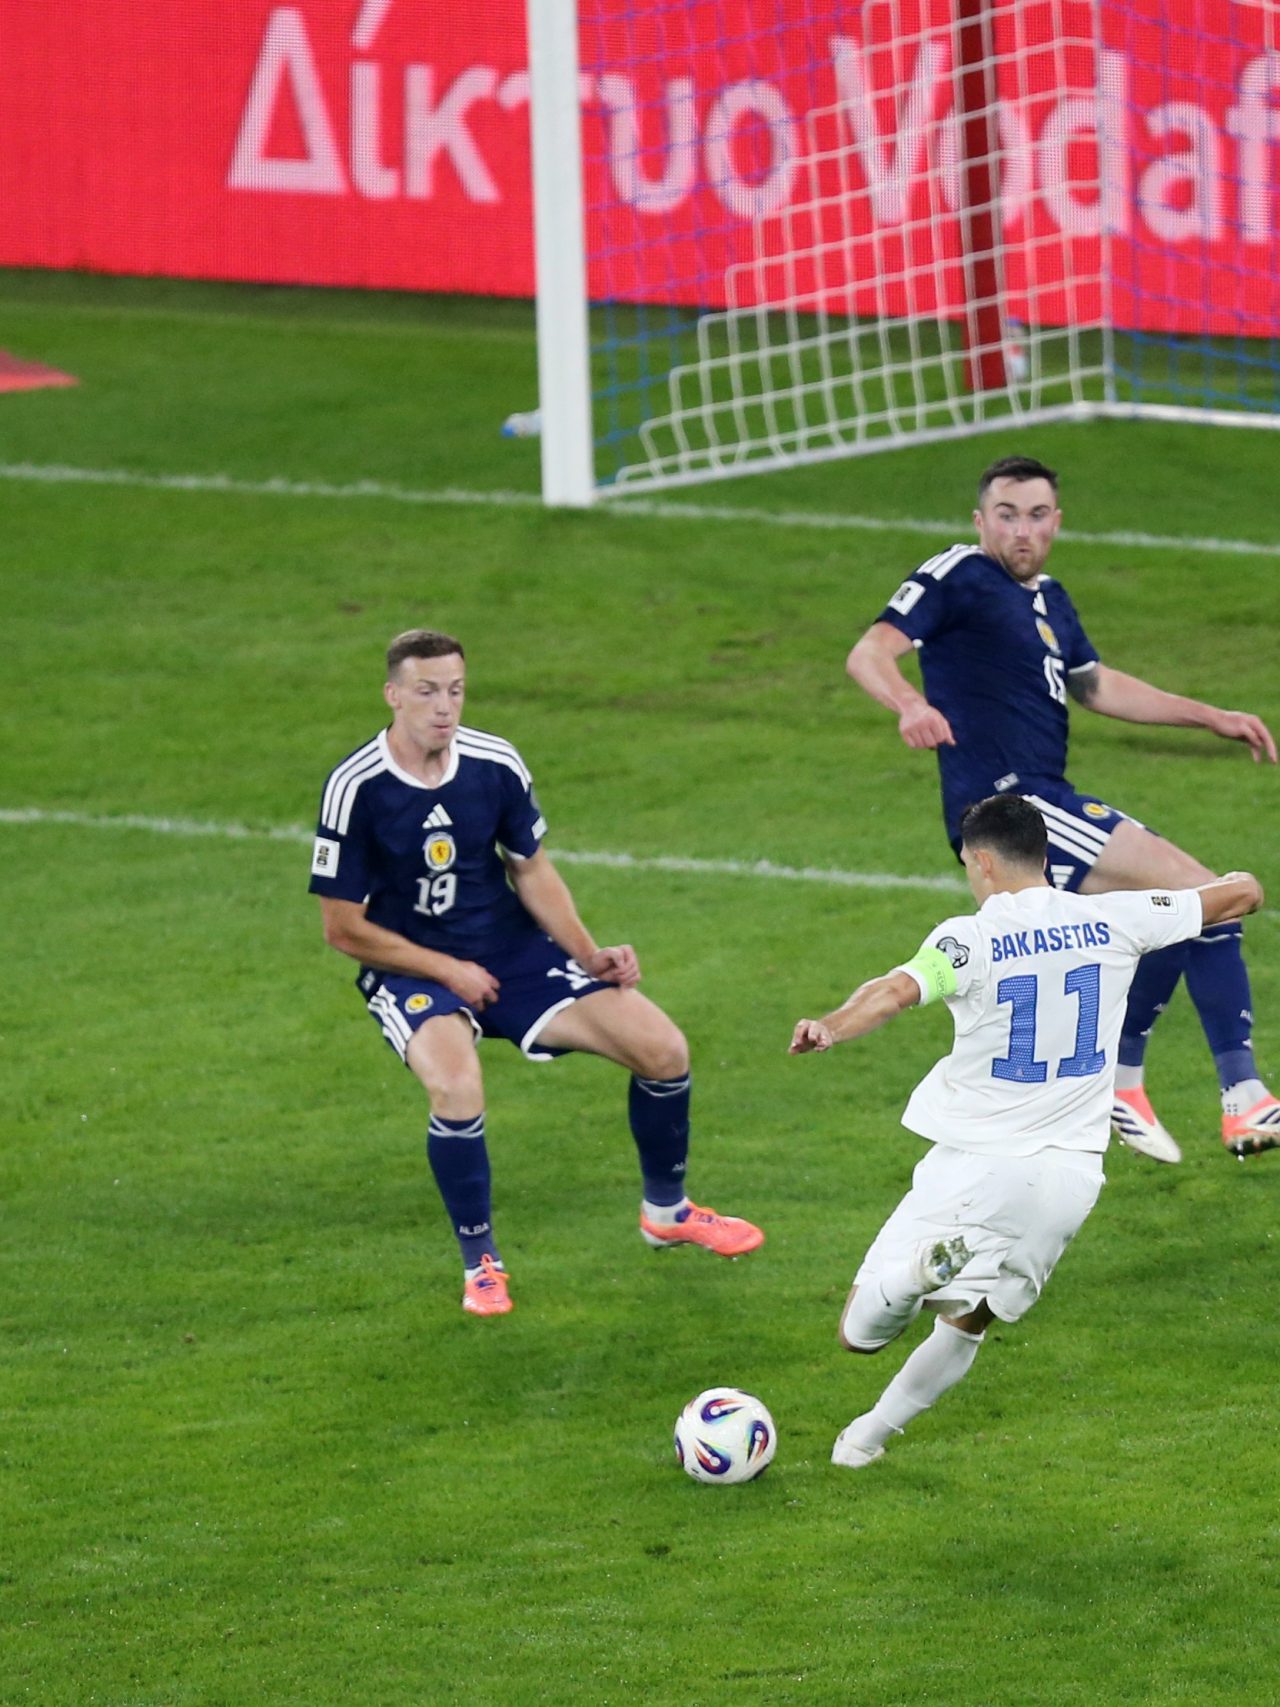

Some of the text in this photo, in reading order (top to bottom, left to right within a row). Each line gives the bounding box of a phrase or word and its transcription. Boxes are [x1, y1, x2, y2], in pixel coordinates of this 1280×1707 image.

[1043, 655, 1067, 705] 15
[413, 872, 458, 916] 19
[991, 921, 1111, 963] BAKASETAS
[991, 963, 1106, 1083] 11
[459, 1222, 489, 1235] ALBA
